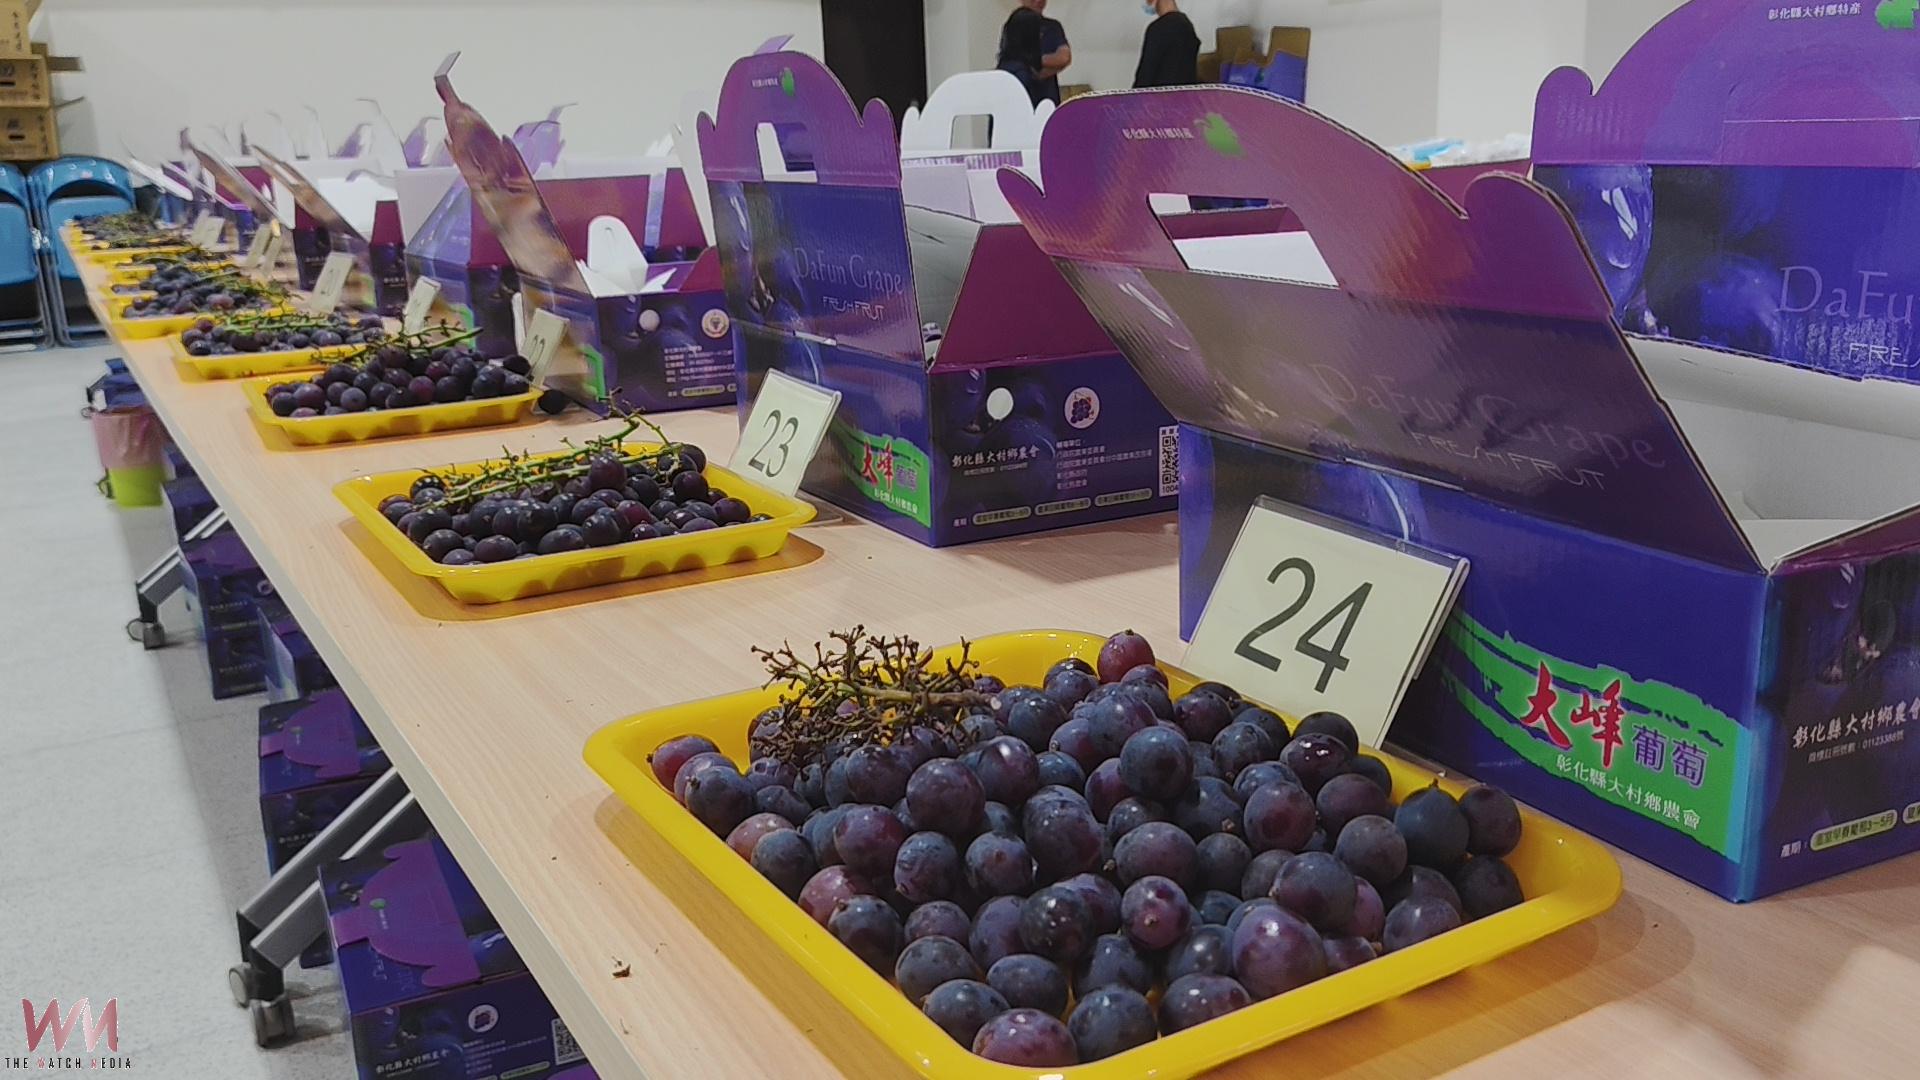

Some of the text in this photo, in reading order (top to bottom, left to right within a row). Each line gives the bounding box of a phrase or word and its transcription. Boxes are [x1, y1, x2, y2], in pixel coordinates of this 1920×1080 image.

[849, 254, 905, 300] Grape
[1774, 265, 1920, 326] DaFu
[748, 409, 799, 478] 23
[1477, 394, 1666, 470] Grape
[1234, 556, 1374, 694] 24
[1555, 754, 1702, 831] 彰化縣大村鄉農會
